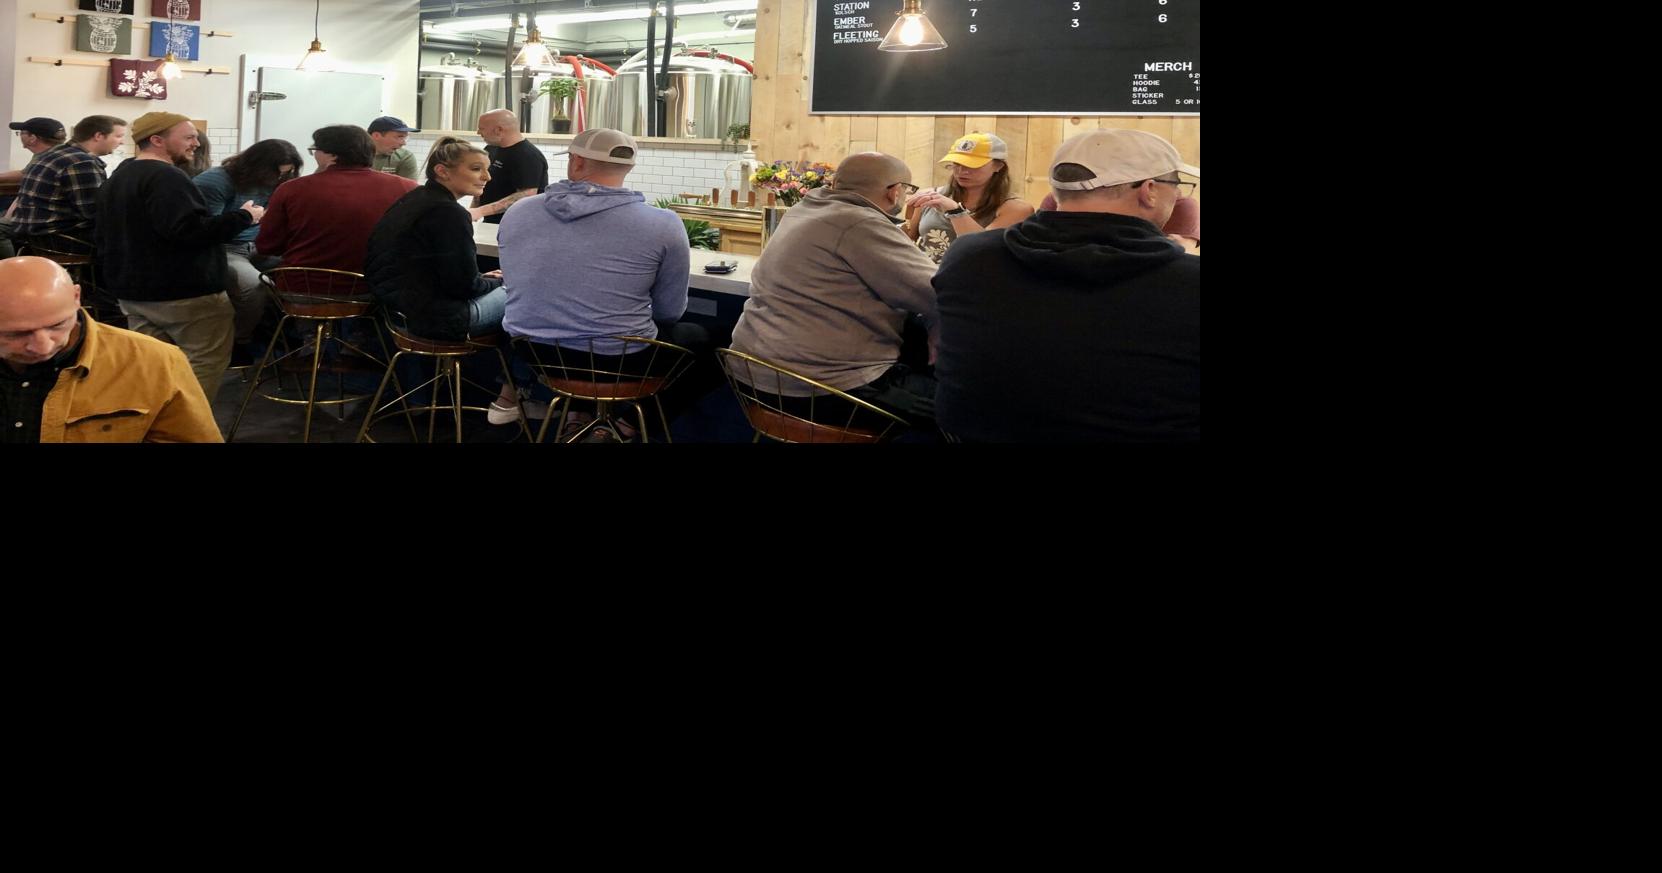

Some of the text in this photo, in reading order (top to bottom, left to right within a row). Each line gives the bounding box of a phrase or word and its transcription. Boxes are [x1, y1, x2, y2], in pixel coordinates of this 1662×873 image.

[833, 1, 870, 11] STATION
[833, 16, 866, 26] EMBER
[970, 8, 978, 17] 7
[1072, 1, 1081, 11] 3
[833, 14, 1168, 40] FLEETING 5 3 6
[1144, 61, 1193, 72] MERCH
